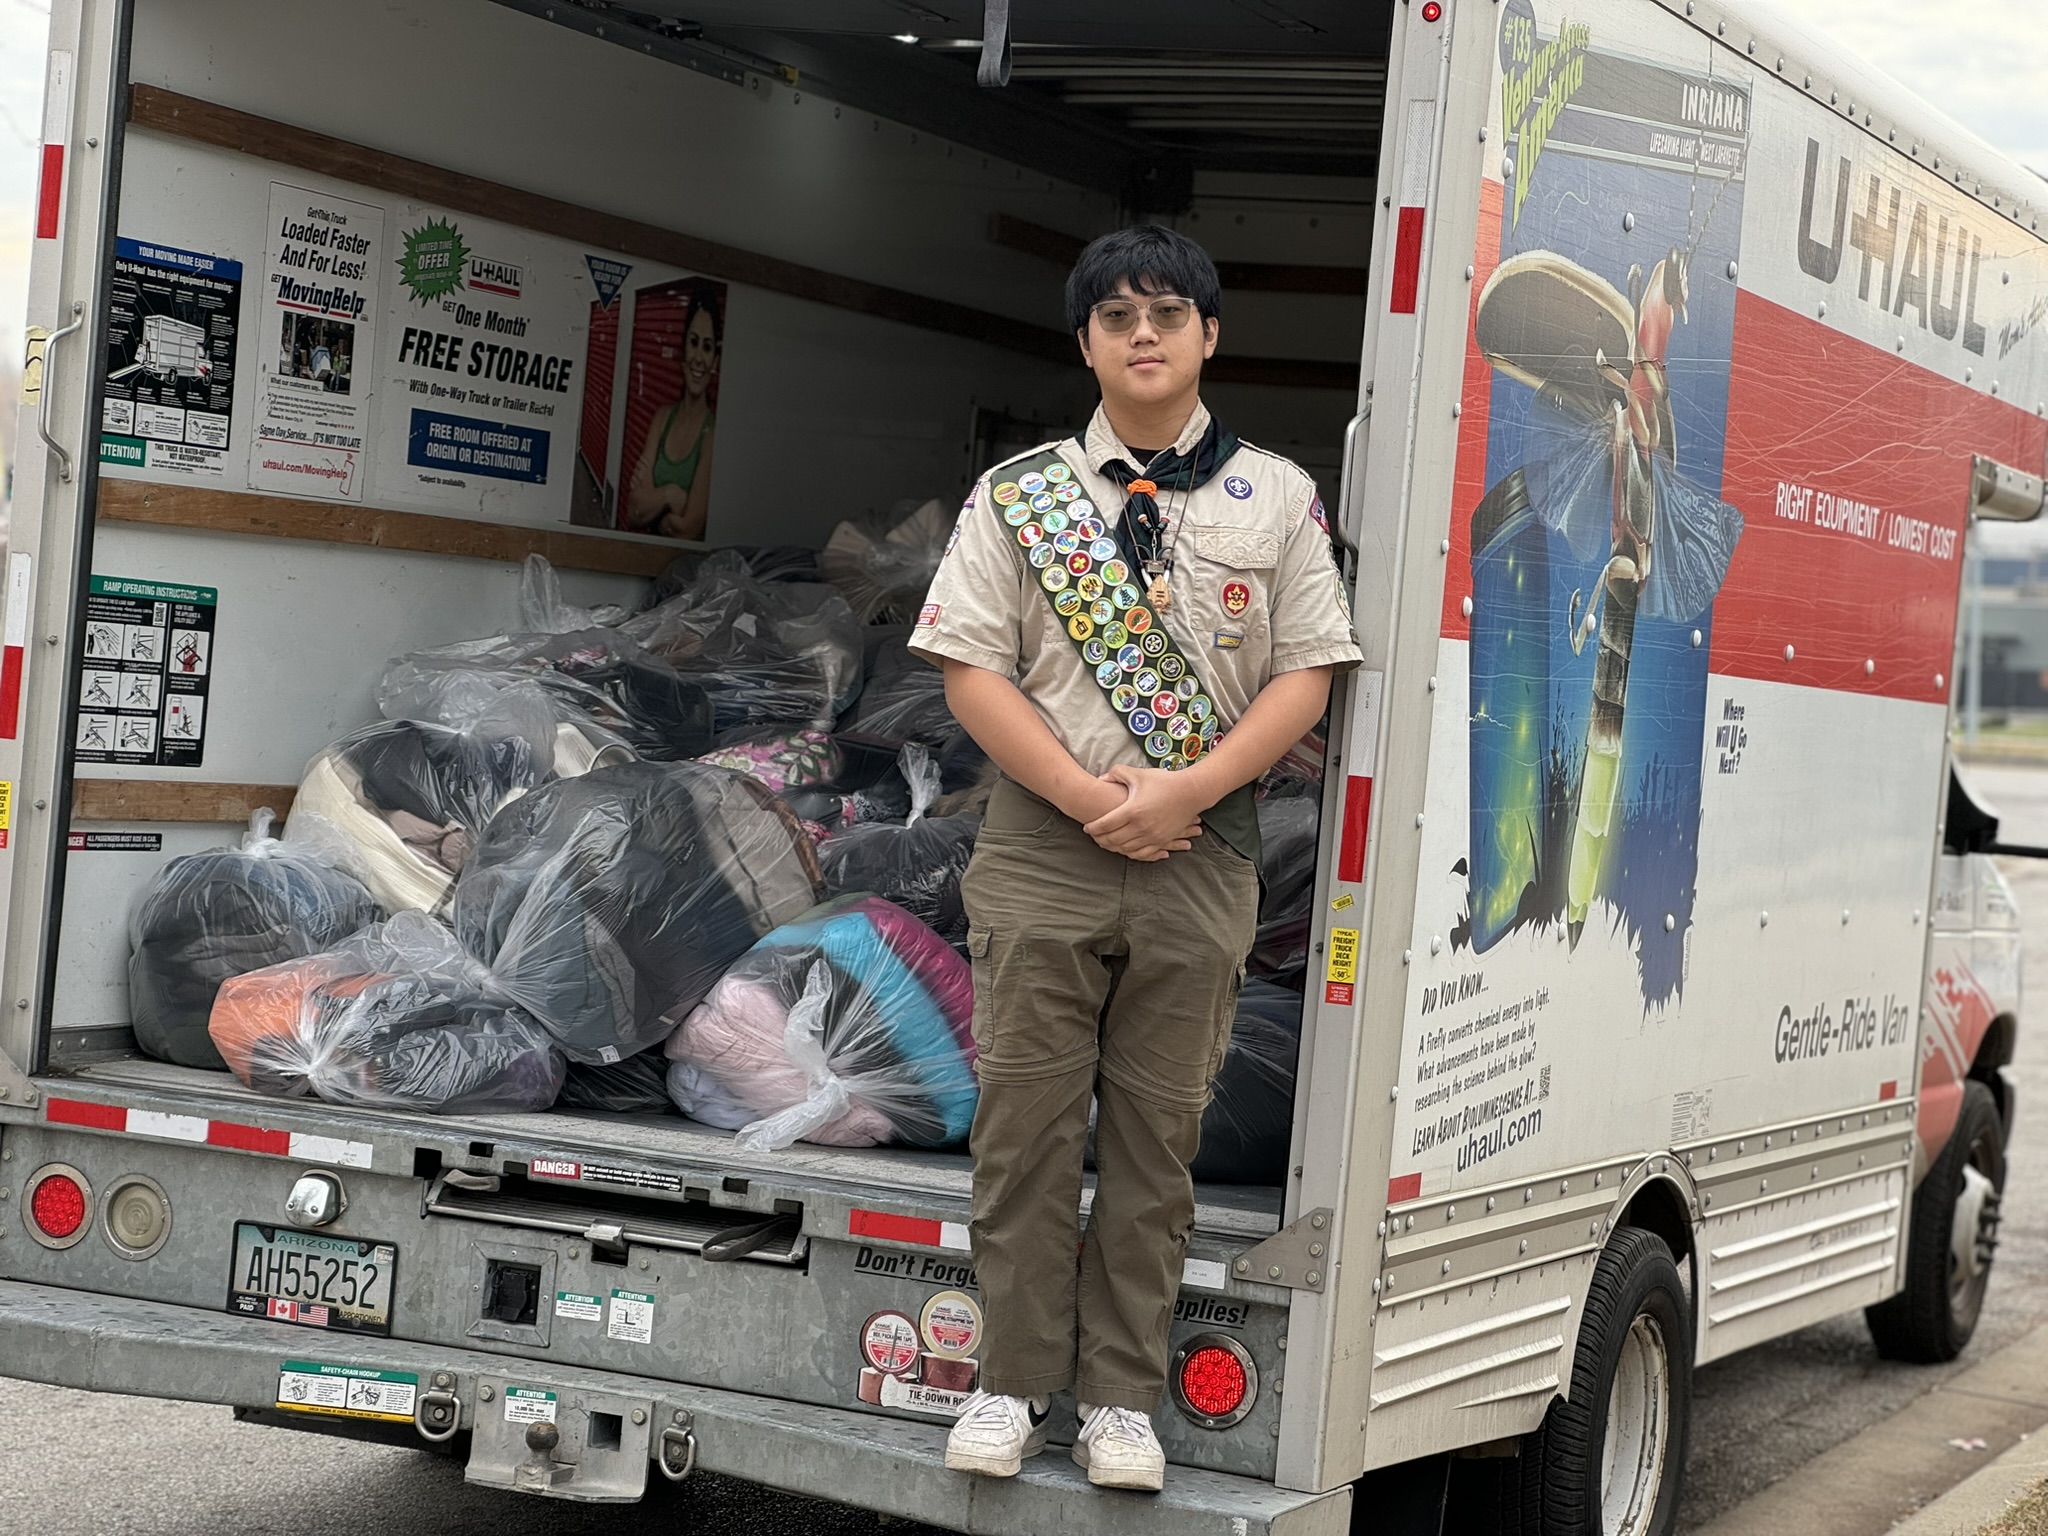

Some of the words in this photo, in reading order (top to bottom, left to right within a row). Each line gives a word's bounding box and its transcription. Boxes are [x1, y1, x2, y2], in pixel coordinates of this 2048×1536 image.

[1504, 16, 1531, 64] #135
[1681, 83, 1743, 131] INDIANA
[1680, 138, 1695, 159] LIGHT
[307, 207, 317, 219] Get
[331, 212, 347, 225] Truck
[281, 217, 329, 246] Loaded
[330, 228, 371, 255] Faster
[415, 241, 438, 252] LIMITED
[439, 240, 453, 250] TIME
[139, 245, 154, 256] YOUR
[155, 249, 177, 263] MOVING
[178, 254, 194, 266] MADE
[194, 257, 214, 270] EASIER
[279, 244, 308, 268] And
[308, 250, 330, 273] For
[331, 255, 366, 280] Less!
[418, 253, 450, 270] OFFER
[115, 260, 127, 273] Only
[147, 267, 156, 277] has
[158, 269, 166, 279] the
[166, 271, 179, 282] right
[180, 274, 205, 286] equipment
[271, 274, 281, 283] GET
[278, 276, 365, 319] MovingHelp
[442, 300, 457, 313] GET
[455, 304, 481, 328] One
[398, 327, 464, 372] FREE
[467, 341, 573, 393] STORAGE
[409, 379, 428, 394] With
[431, 383, 467, 403] One-Way
[468, 390, 490, 406] Truck
[492, 396, 501, 407] or
[502, 396, 528, 413] Trailer
[260, 424, 275, 437] Same
[325, 434, 335, 444] NOT
[336, 435, 347, 446] TOO
[347, 438, 361, 448] LATE
[429, 422, 452, 440] FREE
[453, 426, 480, 445] ROOM
[481, 431, 519, 451] OFFERED
[520, 438, 532, 453] AT
[426, 442, 457, 460] ORIGIN
[458, 447, 471, 462] OR
[472, 450, 532, 472] DESTINATION!
[262, 460, 348, 480] uhaul.com/MovingHelp
[1775, 481, 1813, 523] RIGHT
[1815, 492, 1880, 540] EQUIPMENT
[1878, 511, 1888, 542] /
[1888, 513, 1930, 554] LOWEST
[1930, 525, 1957, 560] COST
[103, 581, 121, 592] RAMP
[122, 583, 155, 596] OPERATING
[156, 586, 198, 600] INSTRUCTIONS
[1723, 698, 1745, 721] Where
[1716, 725, 1731, 748] Will
[1730, 725, 1738, 754] U
[1738, 727, 1747, 748] Go
[1718, 751, 1741, 774] Next?
[1333, 937, 1355, 945] FREIGHT
[1335, 944, 1352, 952] TRUCK
[1332, 959, 1352, 967] HEIGHT
[1336, 952, 1350, 960] DECK
[1422, 987, 1437, 1016] DID
[1439, 980, 1458, 1010] YOU
[1418, 1035, 1425, 1057] A
[1426, 1027, 1447, 1052] firefly
[1448, 1020, 1473, 1045] converts
[1474, 1004, 1501, 1033] chemical
[1502, 1002, 1521, 1022] energy
[1522, 995, 1534, 1014] into
[1535, 986, 1550, 1011] light.
[1775, 997, 1876, 1064] Gentle-Ride
[1881, 994, 1908, 1046] Van
[1417, 1062, 1434, 1085] What
[1436, 1046, 1478, 1077] advancements
[1479, 1037, 1495, 1057] have
[1495, 1032, 1510, 1051] been
[1511, 1020, 1527, 1043] made
[1528, 1020, 1536, 1040] by
[1414, 1078, 1450, 1113] researching
[1452, 1076, 1462, 1097] the
[1463, 1069, 1486, 1091] science
[1486, 1050, 1507, 1082] behind
[1508, 1050, 1518, 1072] the
[1518, 1041, 1537, 1071] glow?
[1412, 1122, 1437, 1157] LEARN
[1436, 1110, 1462, 1145] ABOUT
[1461, 1085, 1524, 1136] BIOLUMINESCENCE
[1456, 1108, 1542, 1173] uhaul.com
[534, 1160, 576, 1176] DANGER
[277, 1234, 356, 1254] ARIZONA
[246, 1246, 378, 1309] AH55252
[855, 1246, 915, 1275] Don't
[920, 1258, 978, 1288] Forge
[1173, 1299, 1250, 1325] pplies!
[239, 1303, 254, 1312] PAID
[565, 1293, 594, 1303] ATTENTION
[617, 1291, 647, 1302] ATTENTION
[339, 1310, 382, 1323] APPORTIONED
[320, 1366, 358, 1377] SAFETY-CHAIN
[359, 1370, 381, 1378] HOOKUP
[516, 1389, 546, 1399] ATTENTION
[909, 1390, 950, 1404] TIE-DOWN
[953, 1397, 968, 1406] RO
